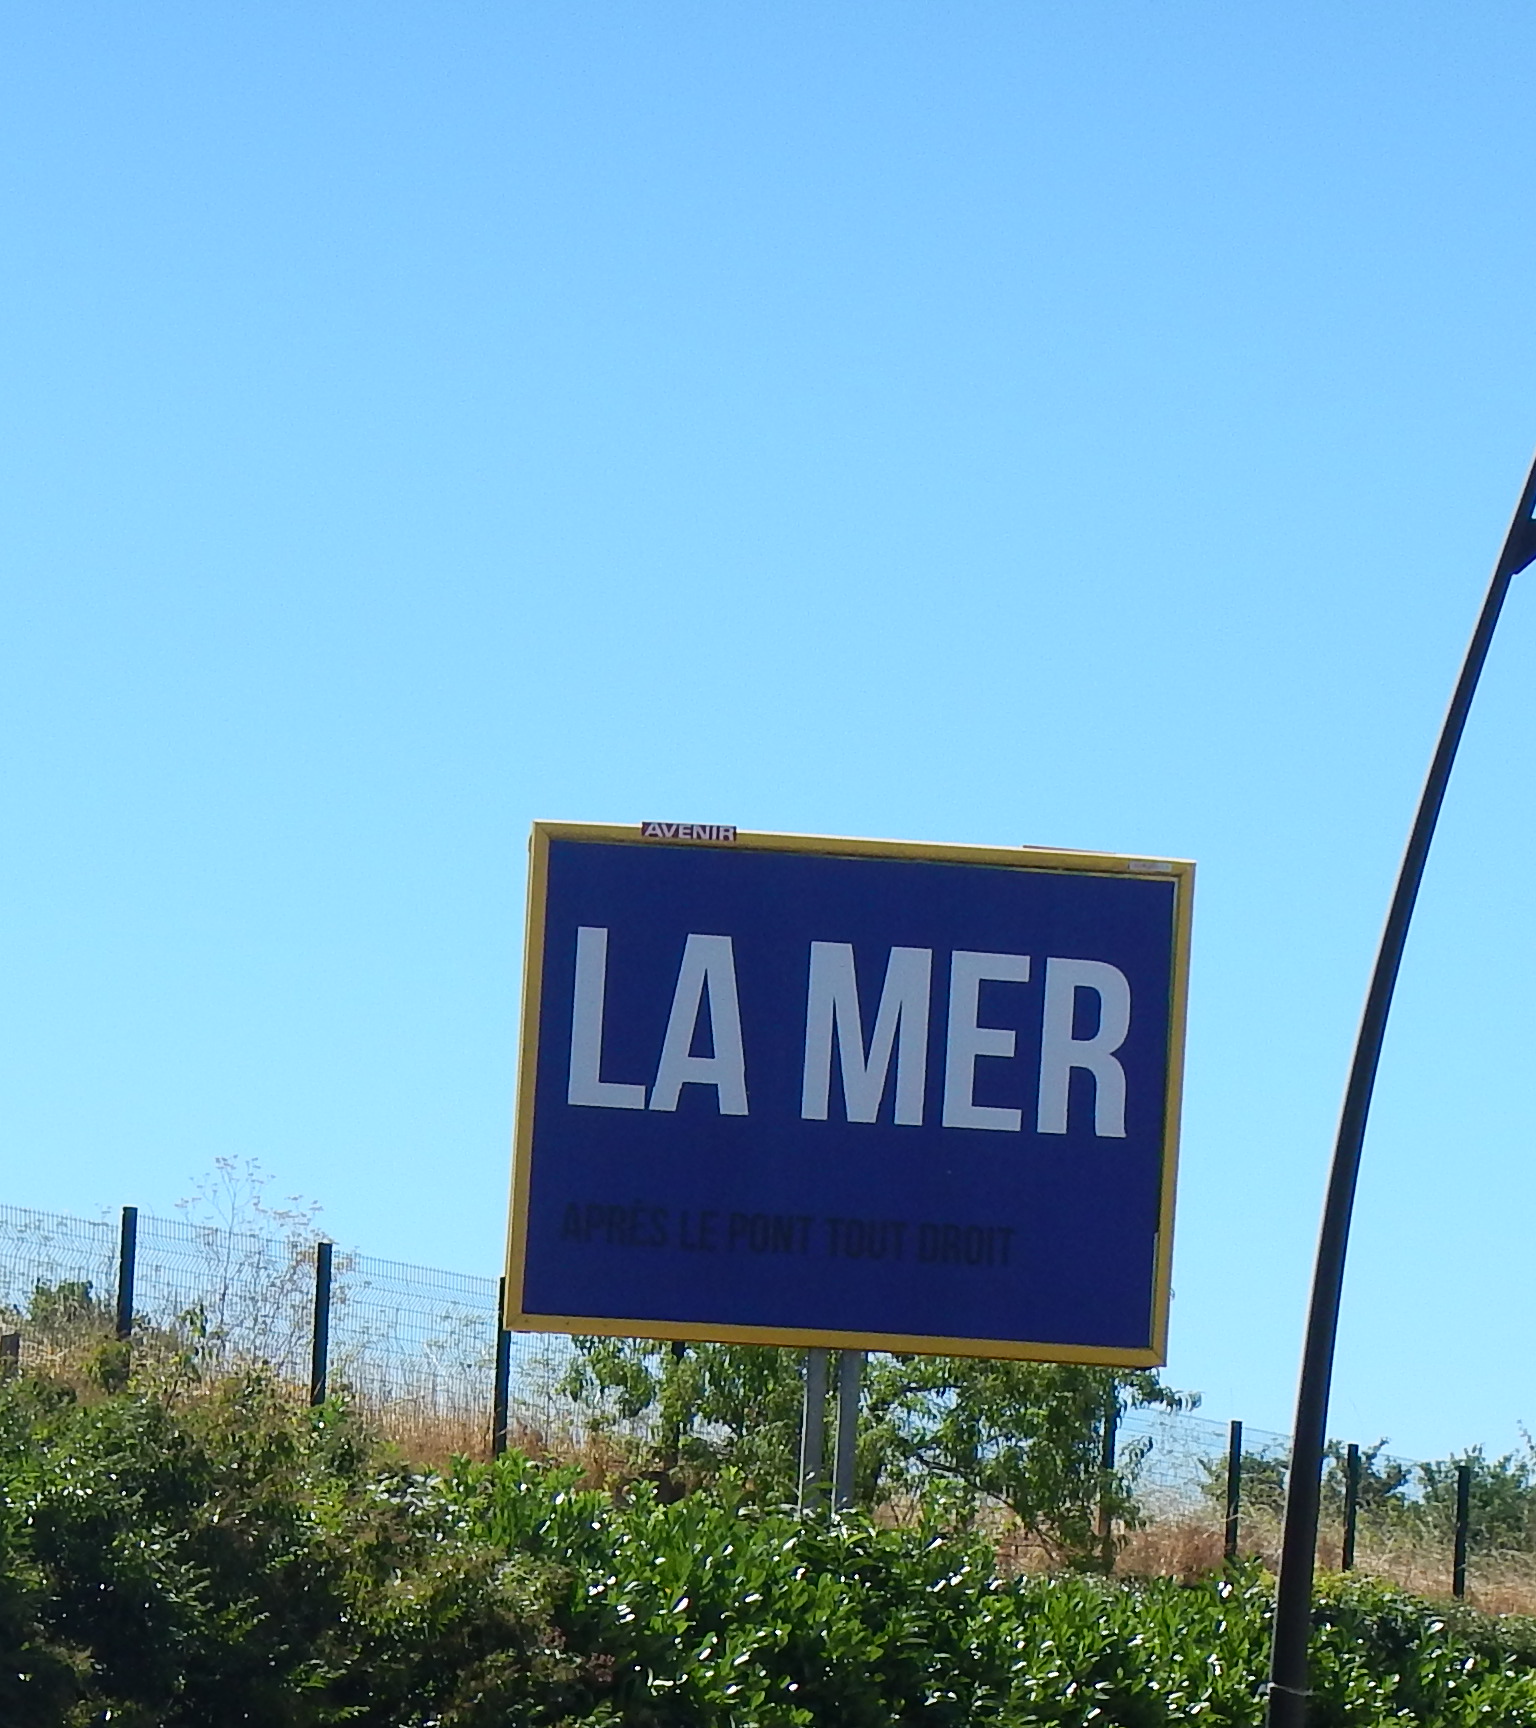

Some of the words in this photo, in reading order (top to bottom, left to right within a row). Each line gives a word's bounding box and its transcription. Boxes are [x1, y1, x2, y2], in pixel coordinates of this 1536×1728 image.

[644, 822, 735, 841] AVENIR
[567, 926, 750, 1116] LA
[801, 940, 1132, 1139] MER
[678, 1210, 719, 1253] LE
[728, 1211, 815, 1255] PONT
[824, 1216, 908, 1260] TOUT
[916, 1221, 1016, 1266] DROIT
